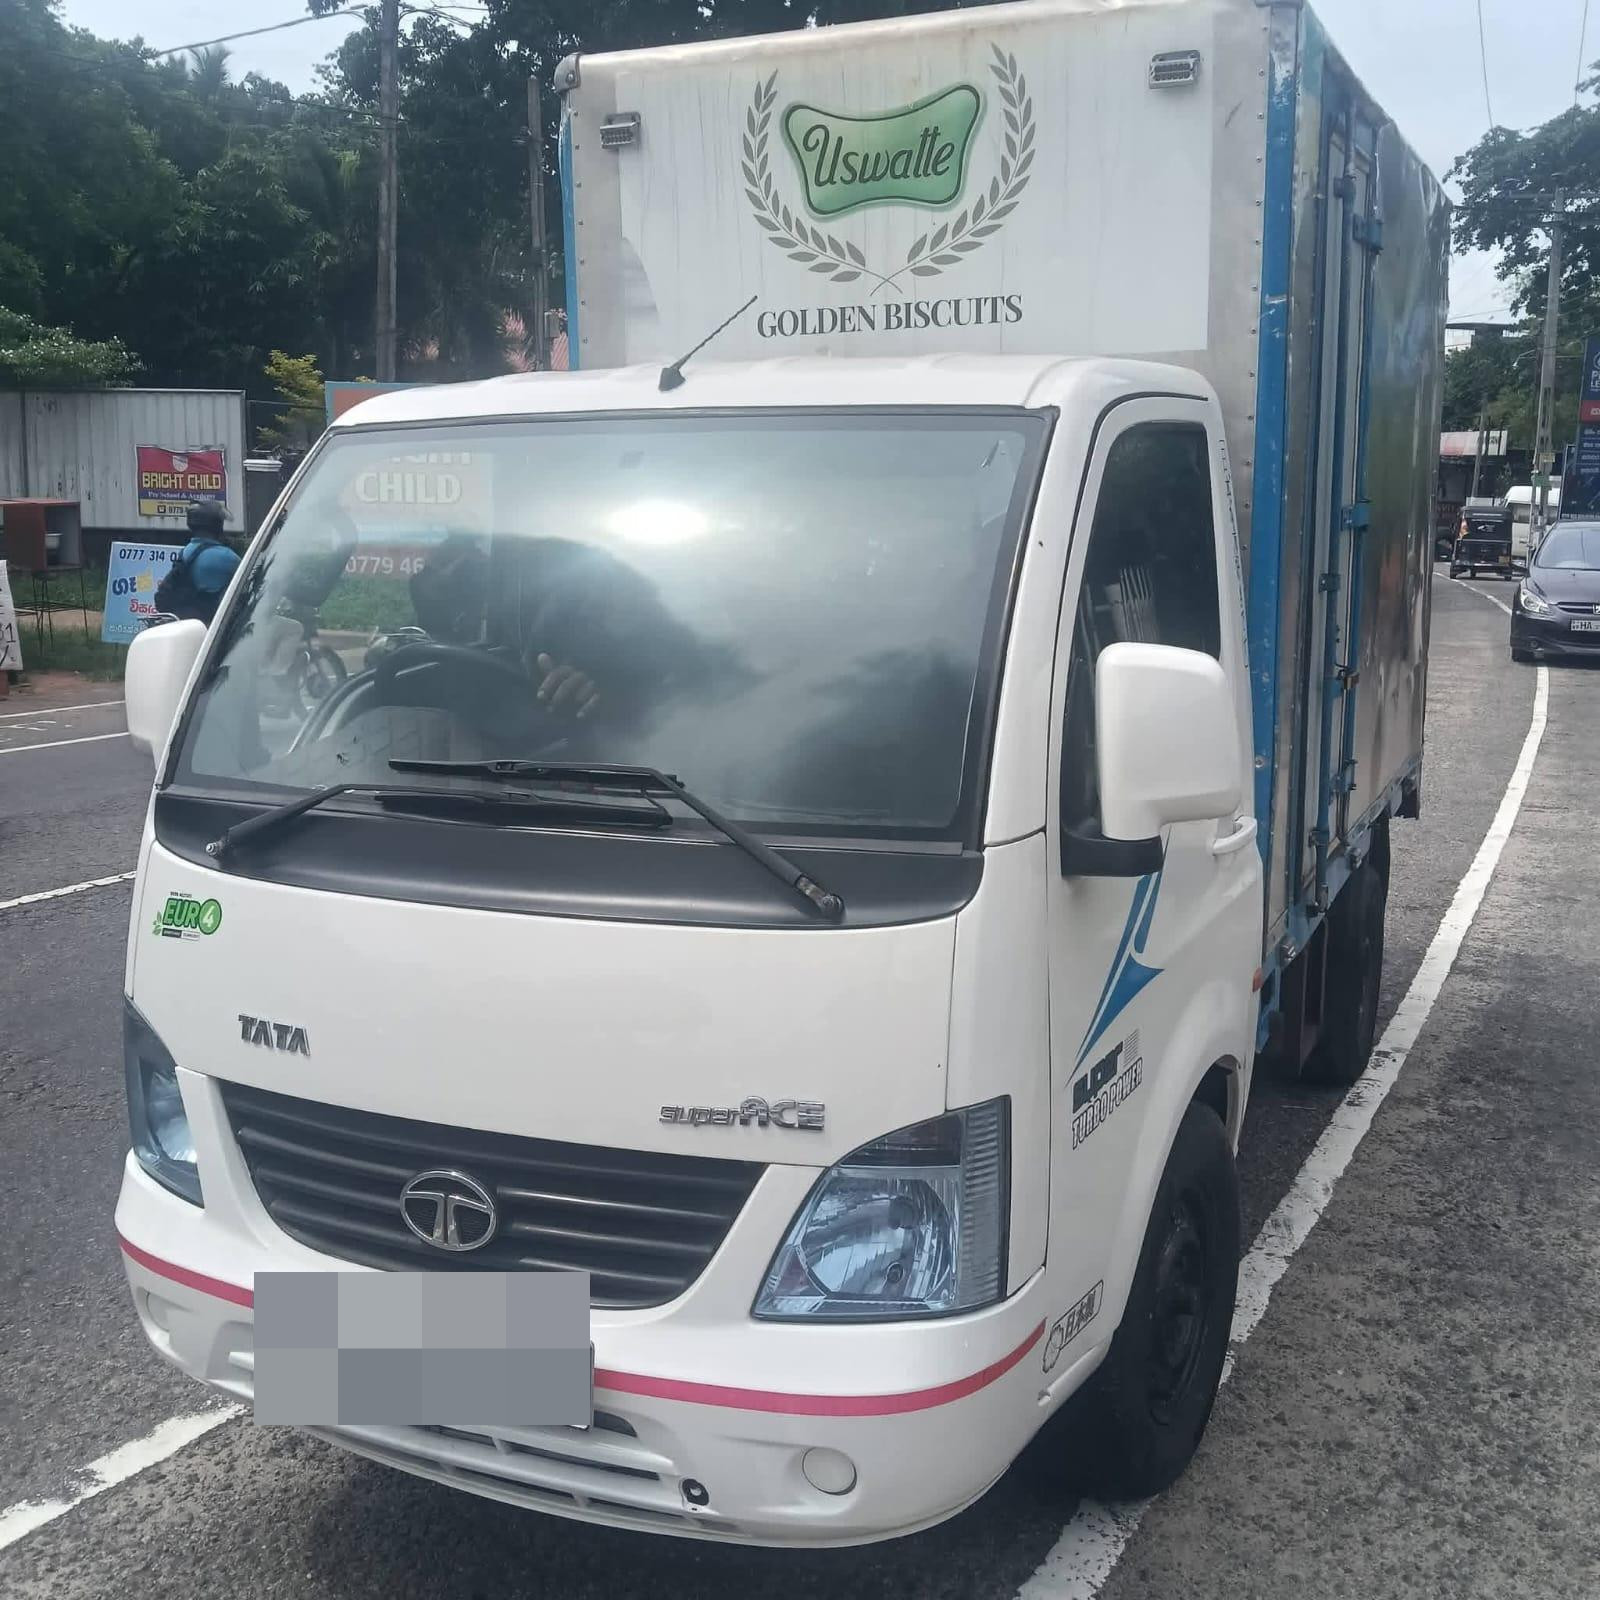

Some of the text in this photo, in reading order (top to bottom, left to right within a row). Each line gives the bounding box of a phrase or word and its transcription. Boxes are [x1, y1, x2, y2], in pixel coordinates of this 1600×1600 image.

[802, 124, 955, 187] Uswatte
[757, 294, 1023, 338] GOLDEN BISCUITS
[142, 471, 221, 490] BRIGHT CHILD
[355, 471, 463, 504] CHILD
[119, 548, 145, 561] 0777
[149, 550, 165, 562] 314
[345, 555, 394, 574] 0779
[238, 1013, 311, 1057] TATA
[1072, 1090, 1109, 1151] TURBO
[1108, 1056, 1143, 1115] POWER
